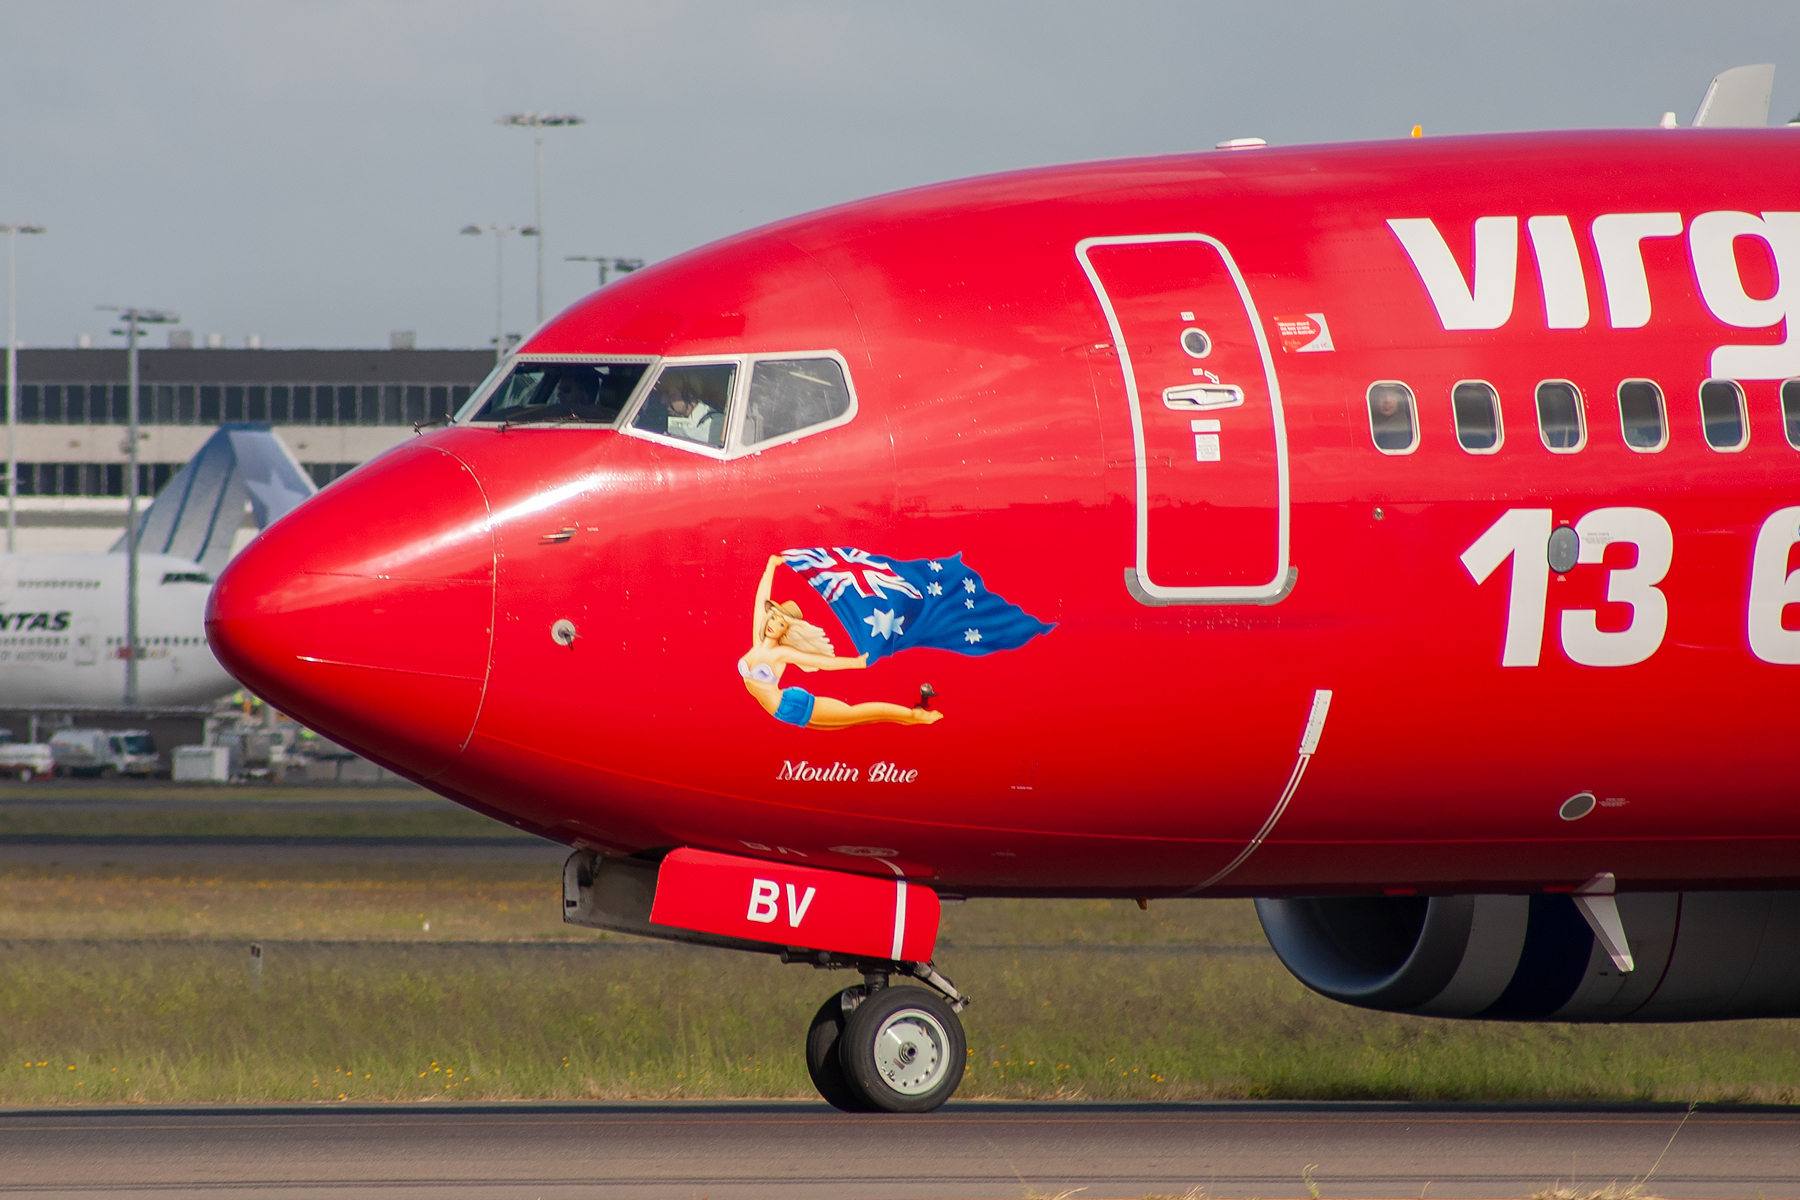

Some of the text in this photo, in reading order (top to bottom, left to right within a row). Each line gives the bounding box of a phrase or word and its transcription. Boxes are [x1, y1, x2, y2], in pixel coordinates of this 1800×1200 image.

[1459, 506, 1674, 668] 13
[776, 759, 919, 784] Moulin Blue
[746, 878, 817, 928] BV
